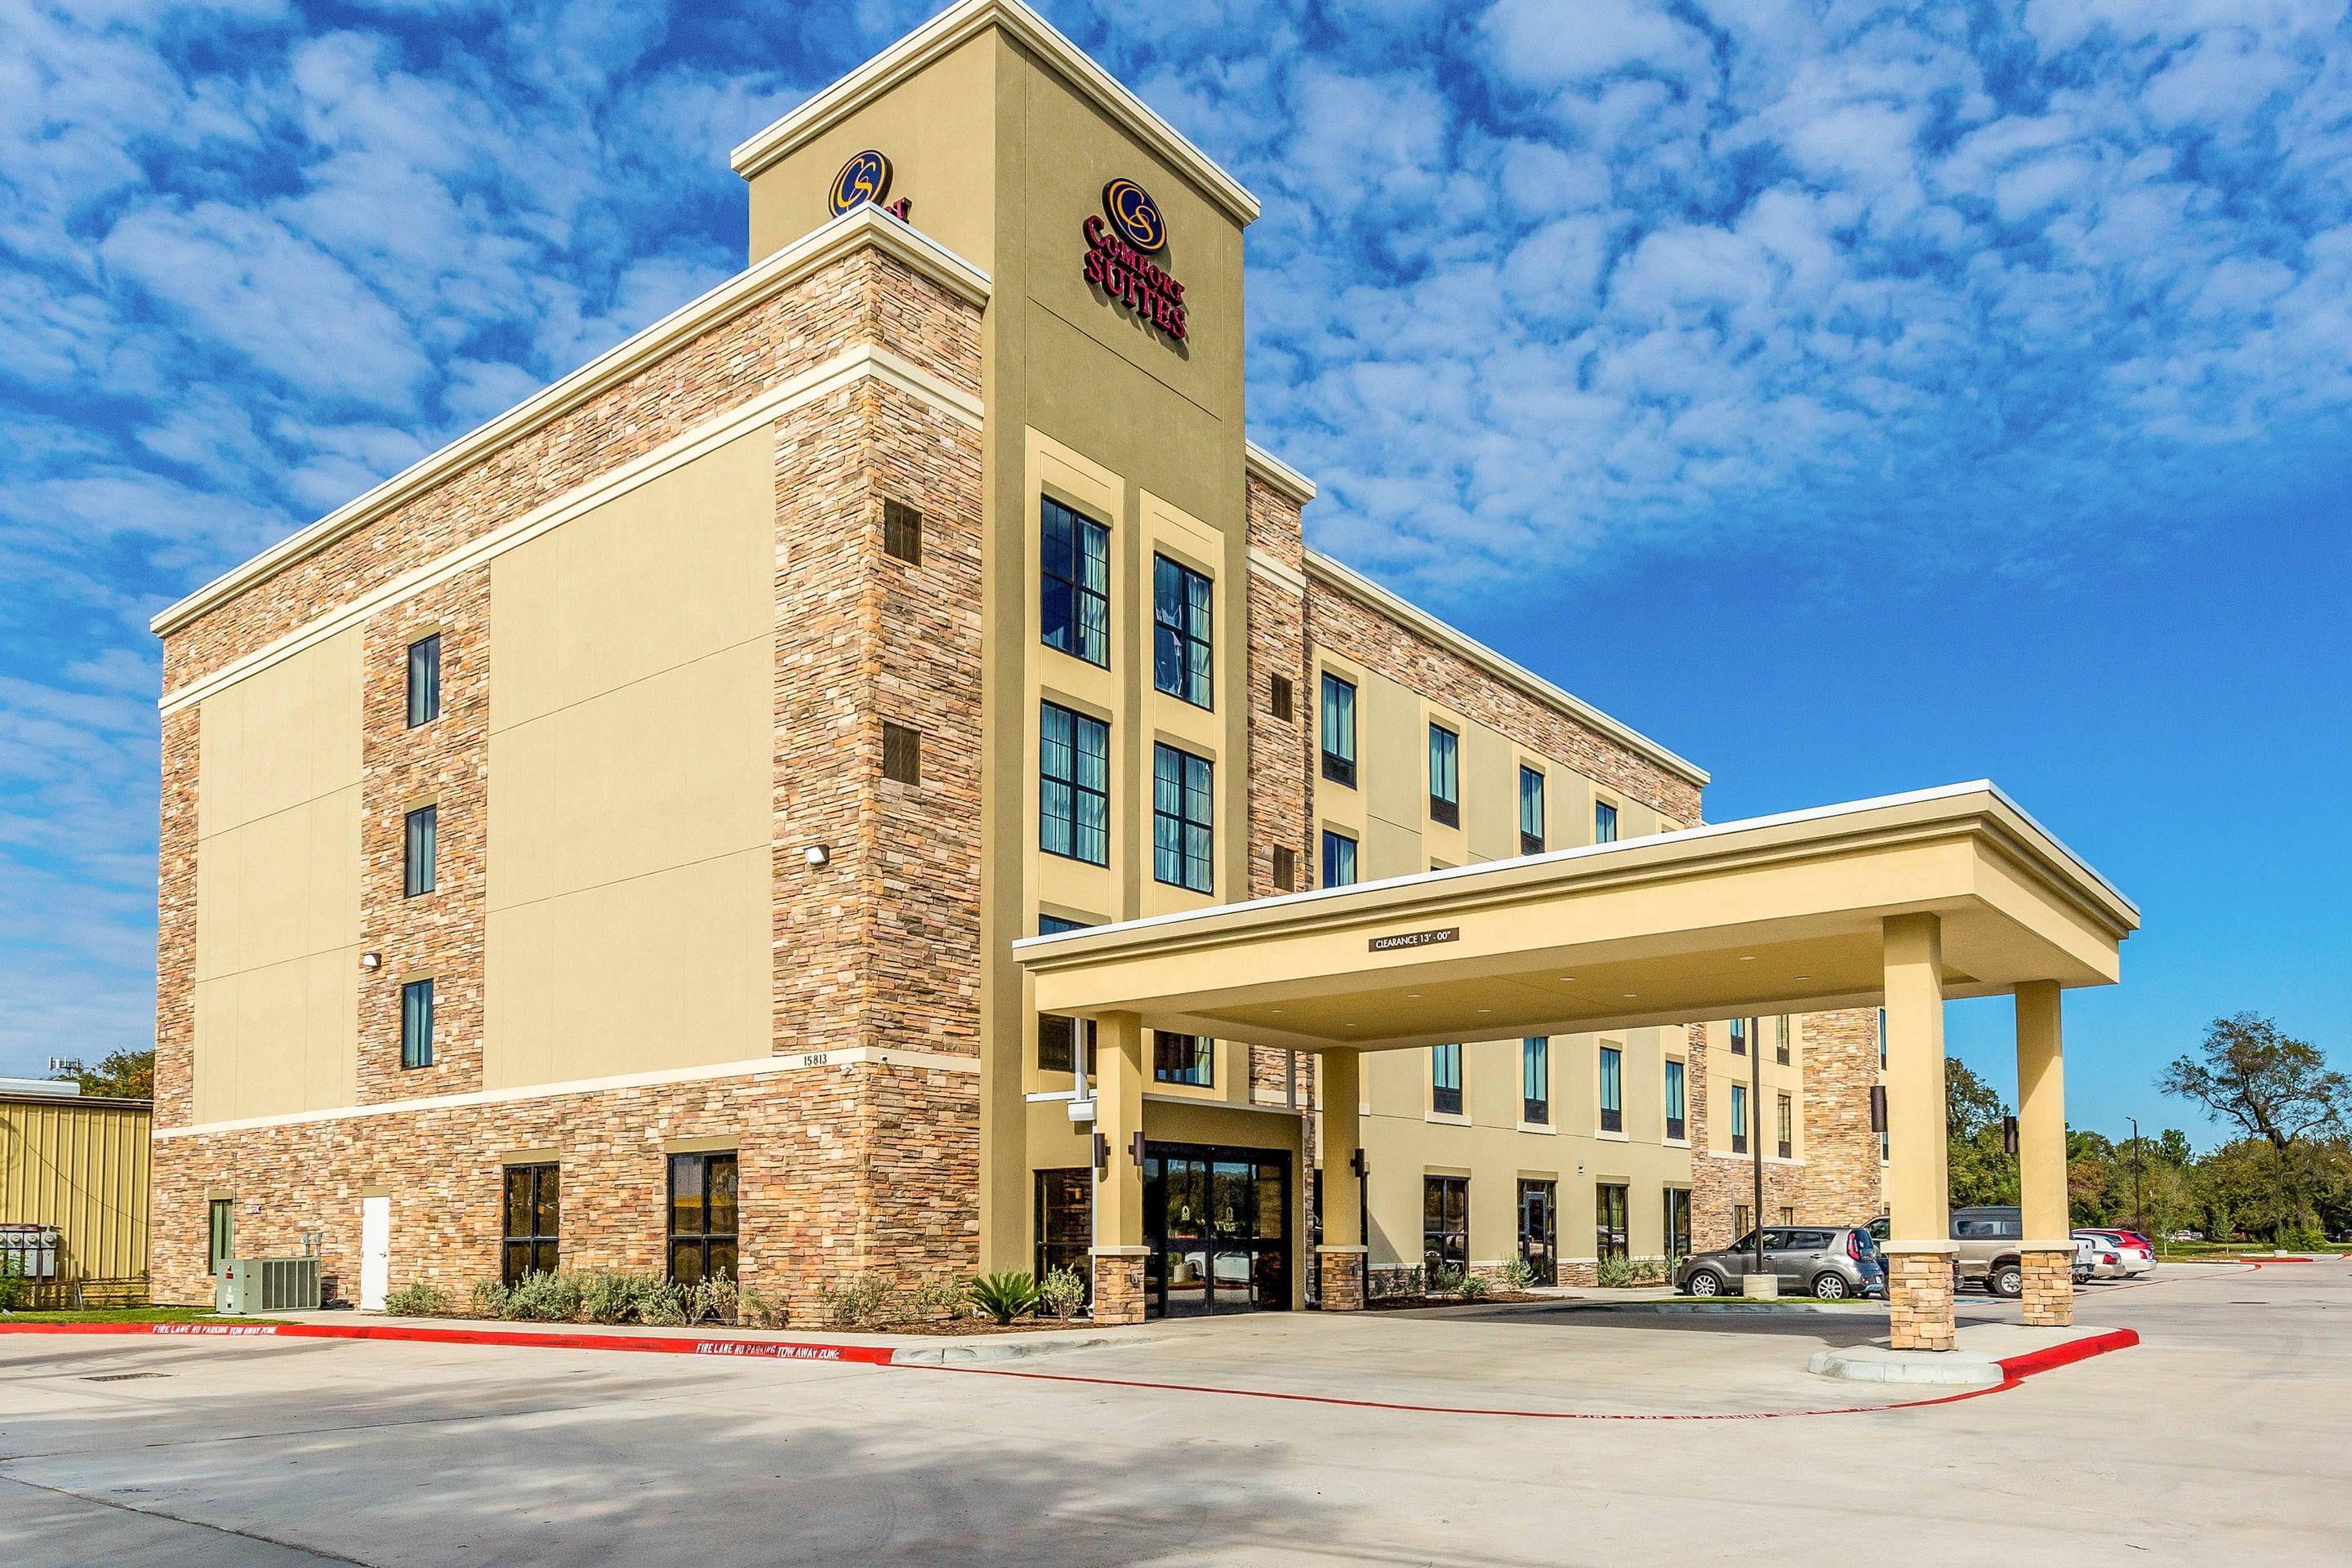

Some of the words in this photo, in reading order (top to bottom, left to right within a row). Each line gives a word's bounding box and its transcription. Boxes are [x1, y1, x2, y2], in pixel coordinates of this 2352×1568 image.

[1083, 249, 1186, 340] SUITES
[1375, 935, 1418, 948] CLEARANCE
[804, 1054, 827, 1066] 15813
[153, 1325, 171, 1334] FIRE
[171, 1325, 192, 1334] LANE
[191, 1325, 202, 1334] NO
[202, 1325, 229, 1334] PARKING
[229, 1326, 245, 1335] TOW
[243, 1327, 261, 1335] AWAY
[696, 1343, 714, 1353] FIRE
[713, 1343, 734, 1354] LANE
[734, 1343, 745, 1355] NO
[746, 1344, 777, 1355] PARKING
[777, 1346, 796, 1357] TOW
[795, 1347, 817, 1359] AWAY
[817, 1348, 840, 1360] ZONE
